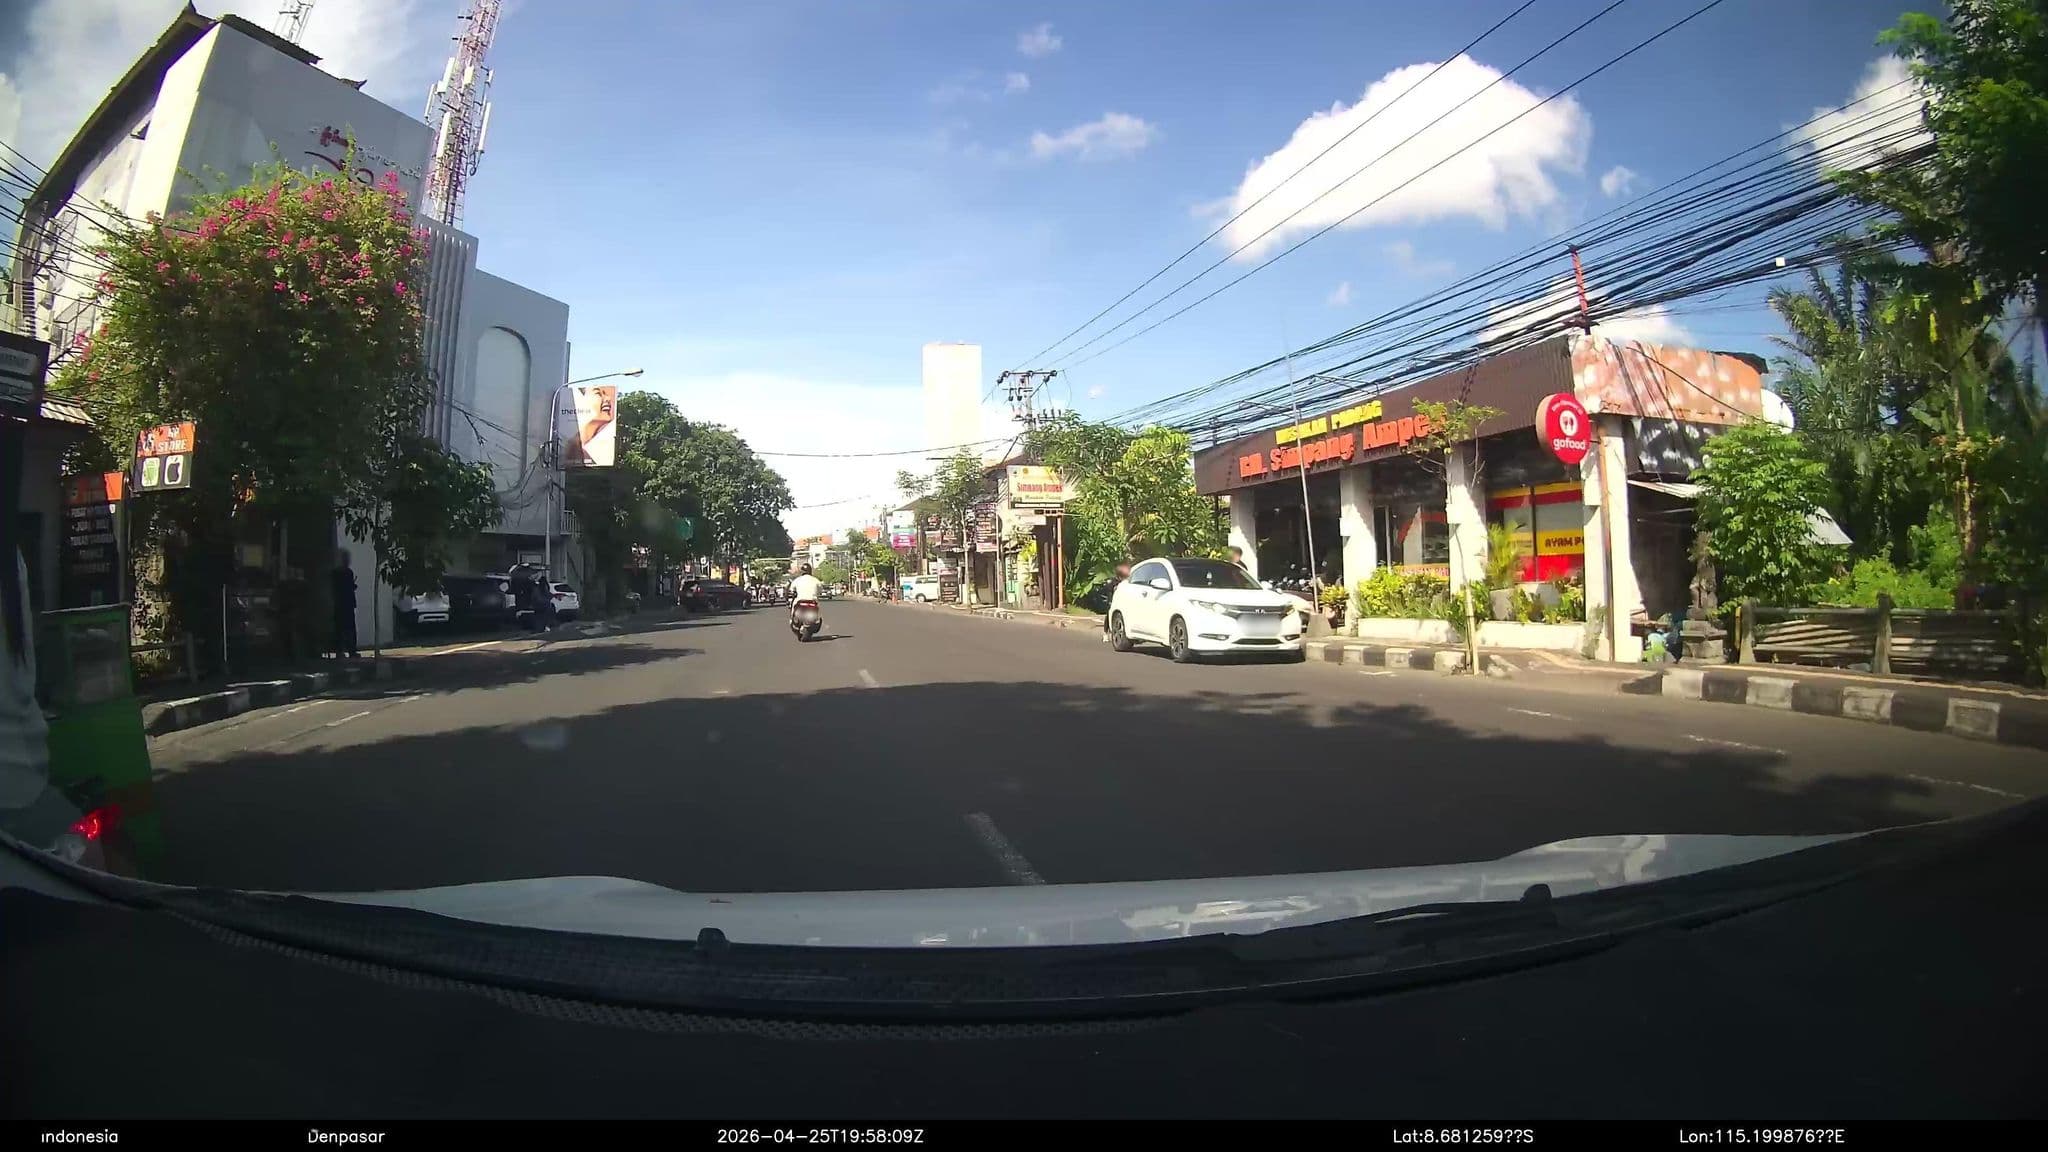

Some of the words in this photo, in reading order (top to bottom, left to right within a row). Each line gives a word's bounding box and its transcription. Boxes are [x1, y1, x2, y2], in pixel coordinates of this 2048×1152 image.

[158, 439, 188, 452] STORE
[1553, 437, 1586, 450] gofood
[1270, 433, 1354, 472] Simpang
[1545, 537, 1573, 548] AYAM
